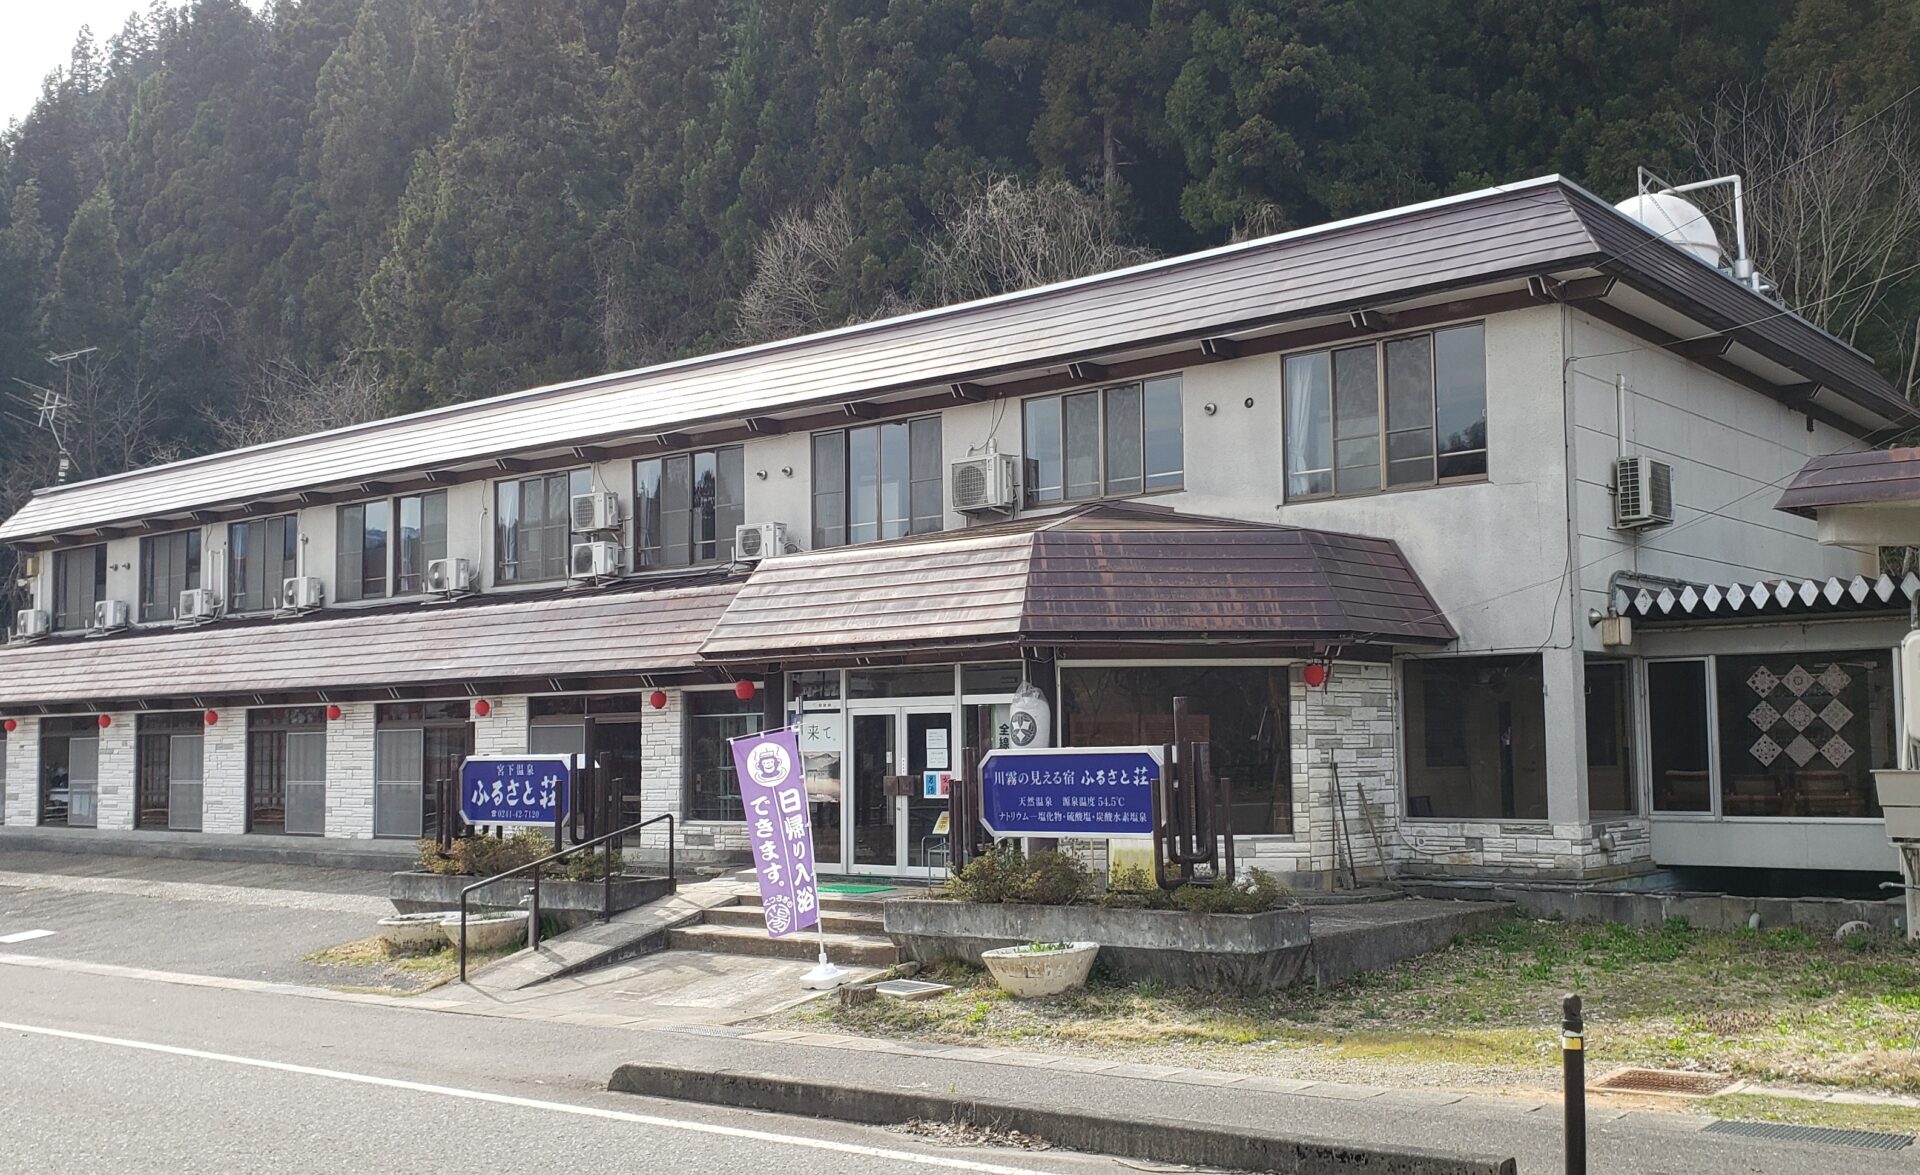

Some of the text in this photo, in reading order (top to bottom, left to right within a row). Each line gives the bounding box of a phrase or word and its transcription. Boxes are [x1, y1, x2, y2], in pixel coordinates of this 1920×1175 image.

[496, 763, 535, 776] 宮下温泉
[993, 766, 1149, 787] 川霧の見える宿 ふるさと荘
[471, 774, 557, 809] ふるさと荘
[1018, 796, 1053, 807] 天然温泉
[749, 795, 785, 888] できます。
[778, 788, 815, 914] 日帰り入浴
